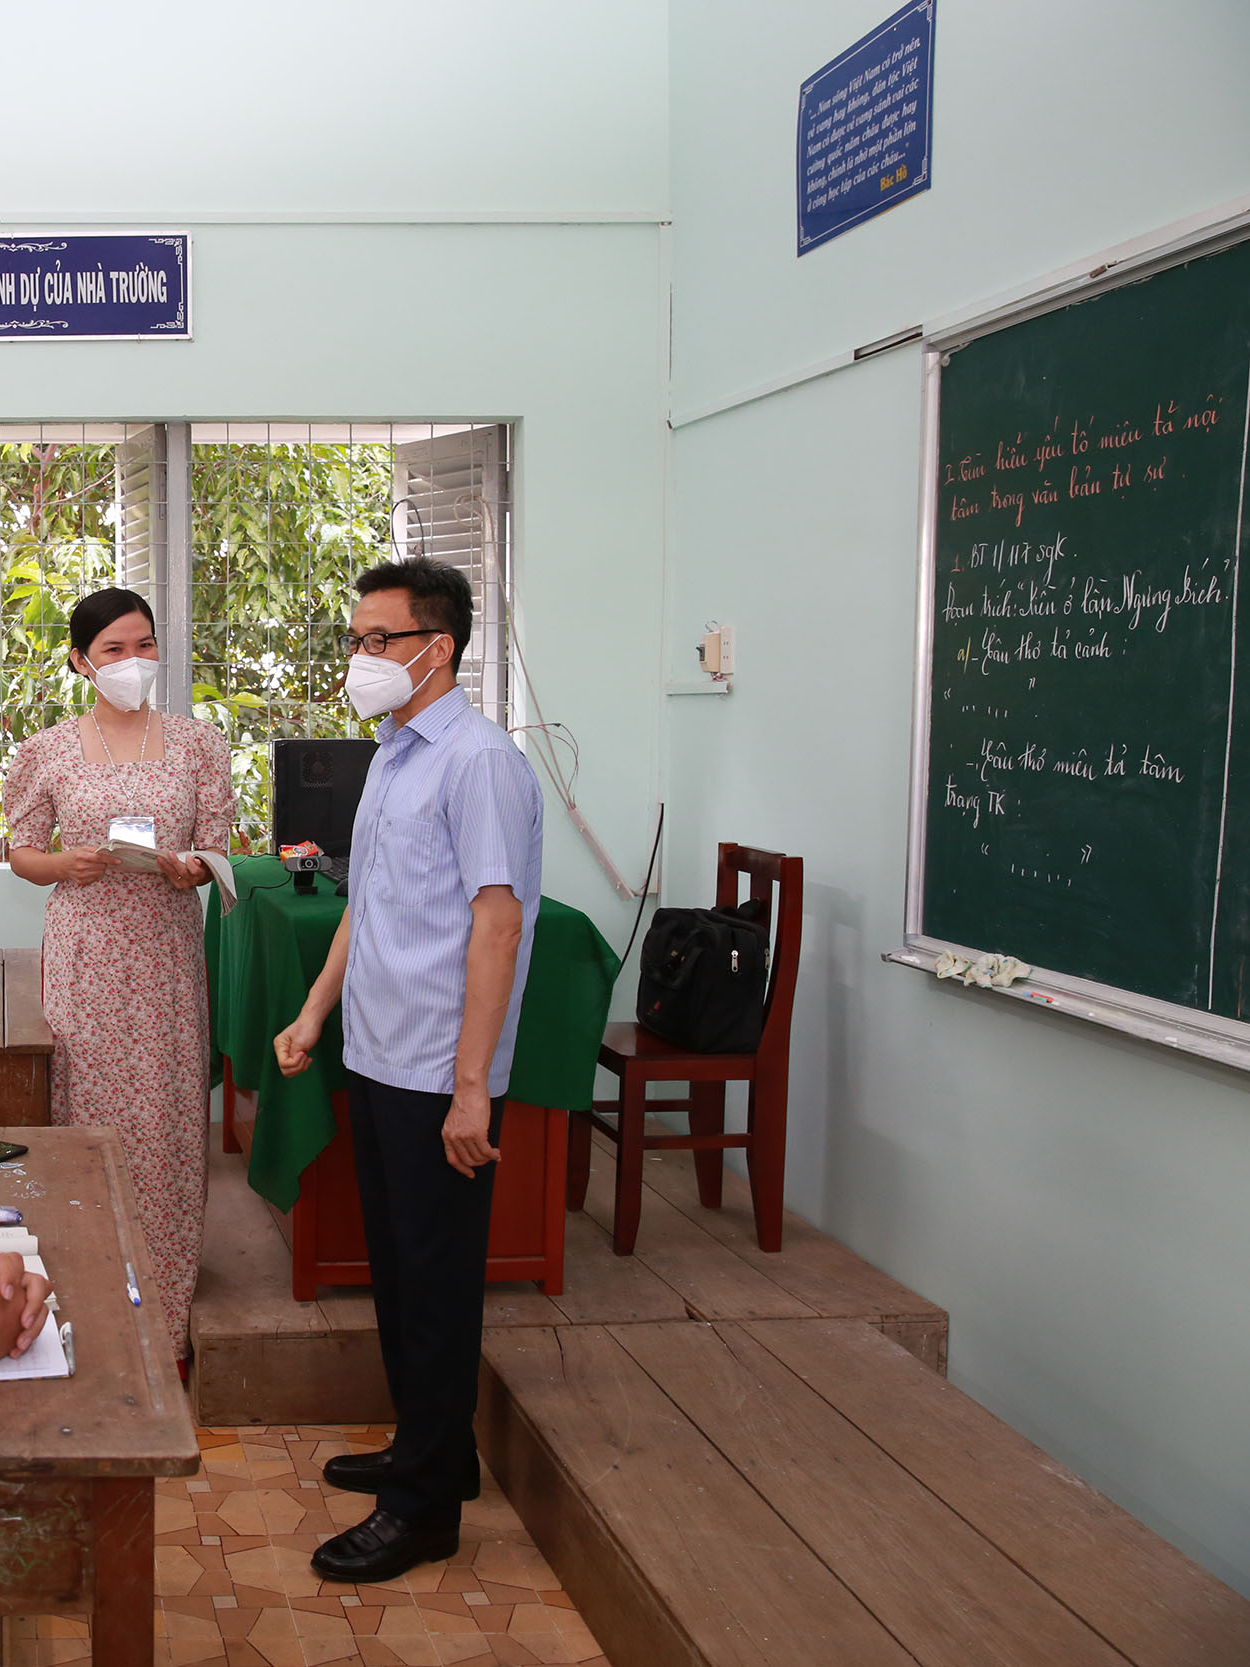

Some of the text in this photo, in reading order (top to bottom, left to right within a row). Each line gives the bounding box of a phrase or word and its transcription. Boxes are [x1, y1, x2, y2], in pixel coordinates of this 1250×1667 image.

[880, 163, 908, 191] Bác Hồ
[20, 266, 41, 312] DỰ
[44, 259, 74, 306] CỦA
[77, 262, 107, 304] NHÀ
[109, 261, 168, 304] TRƯỜNG
